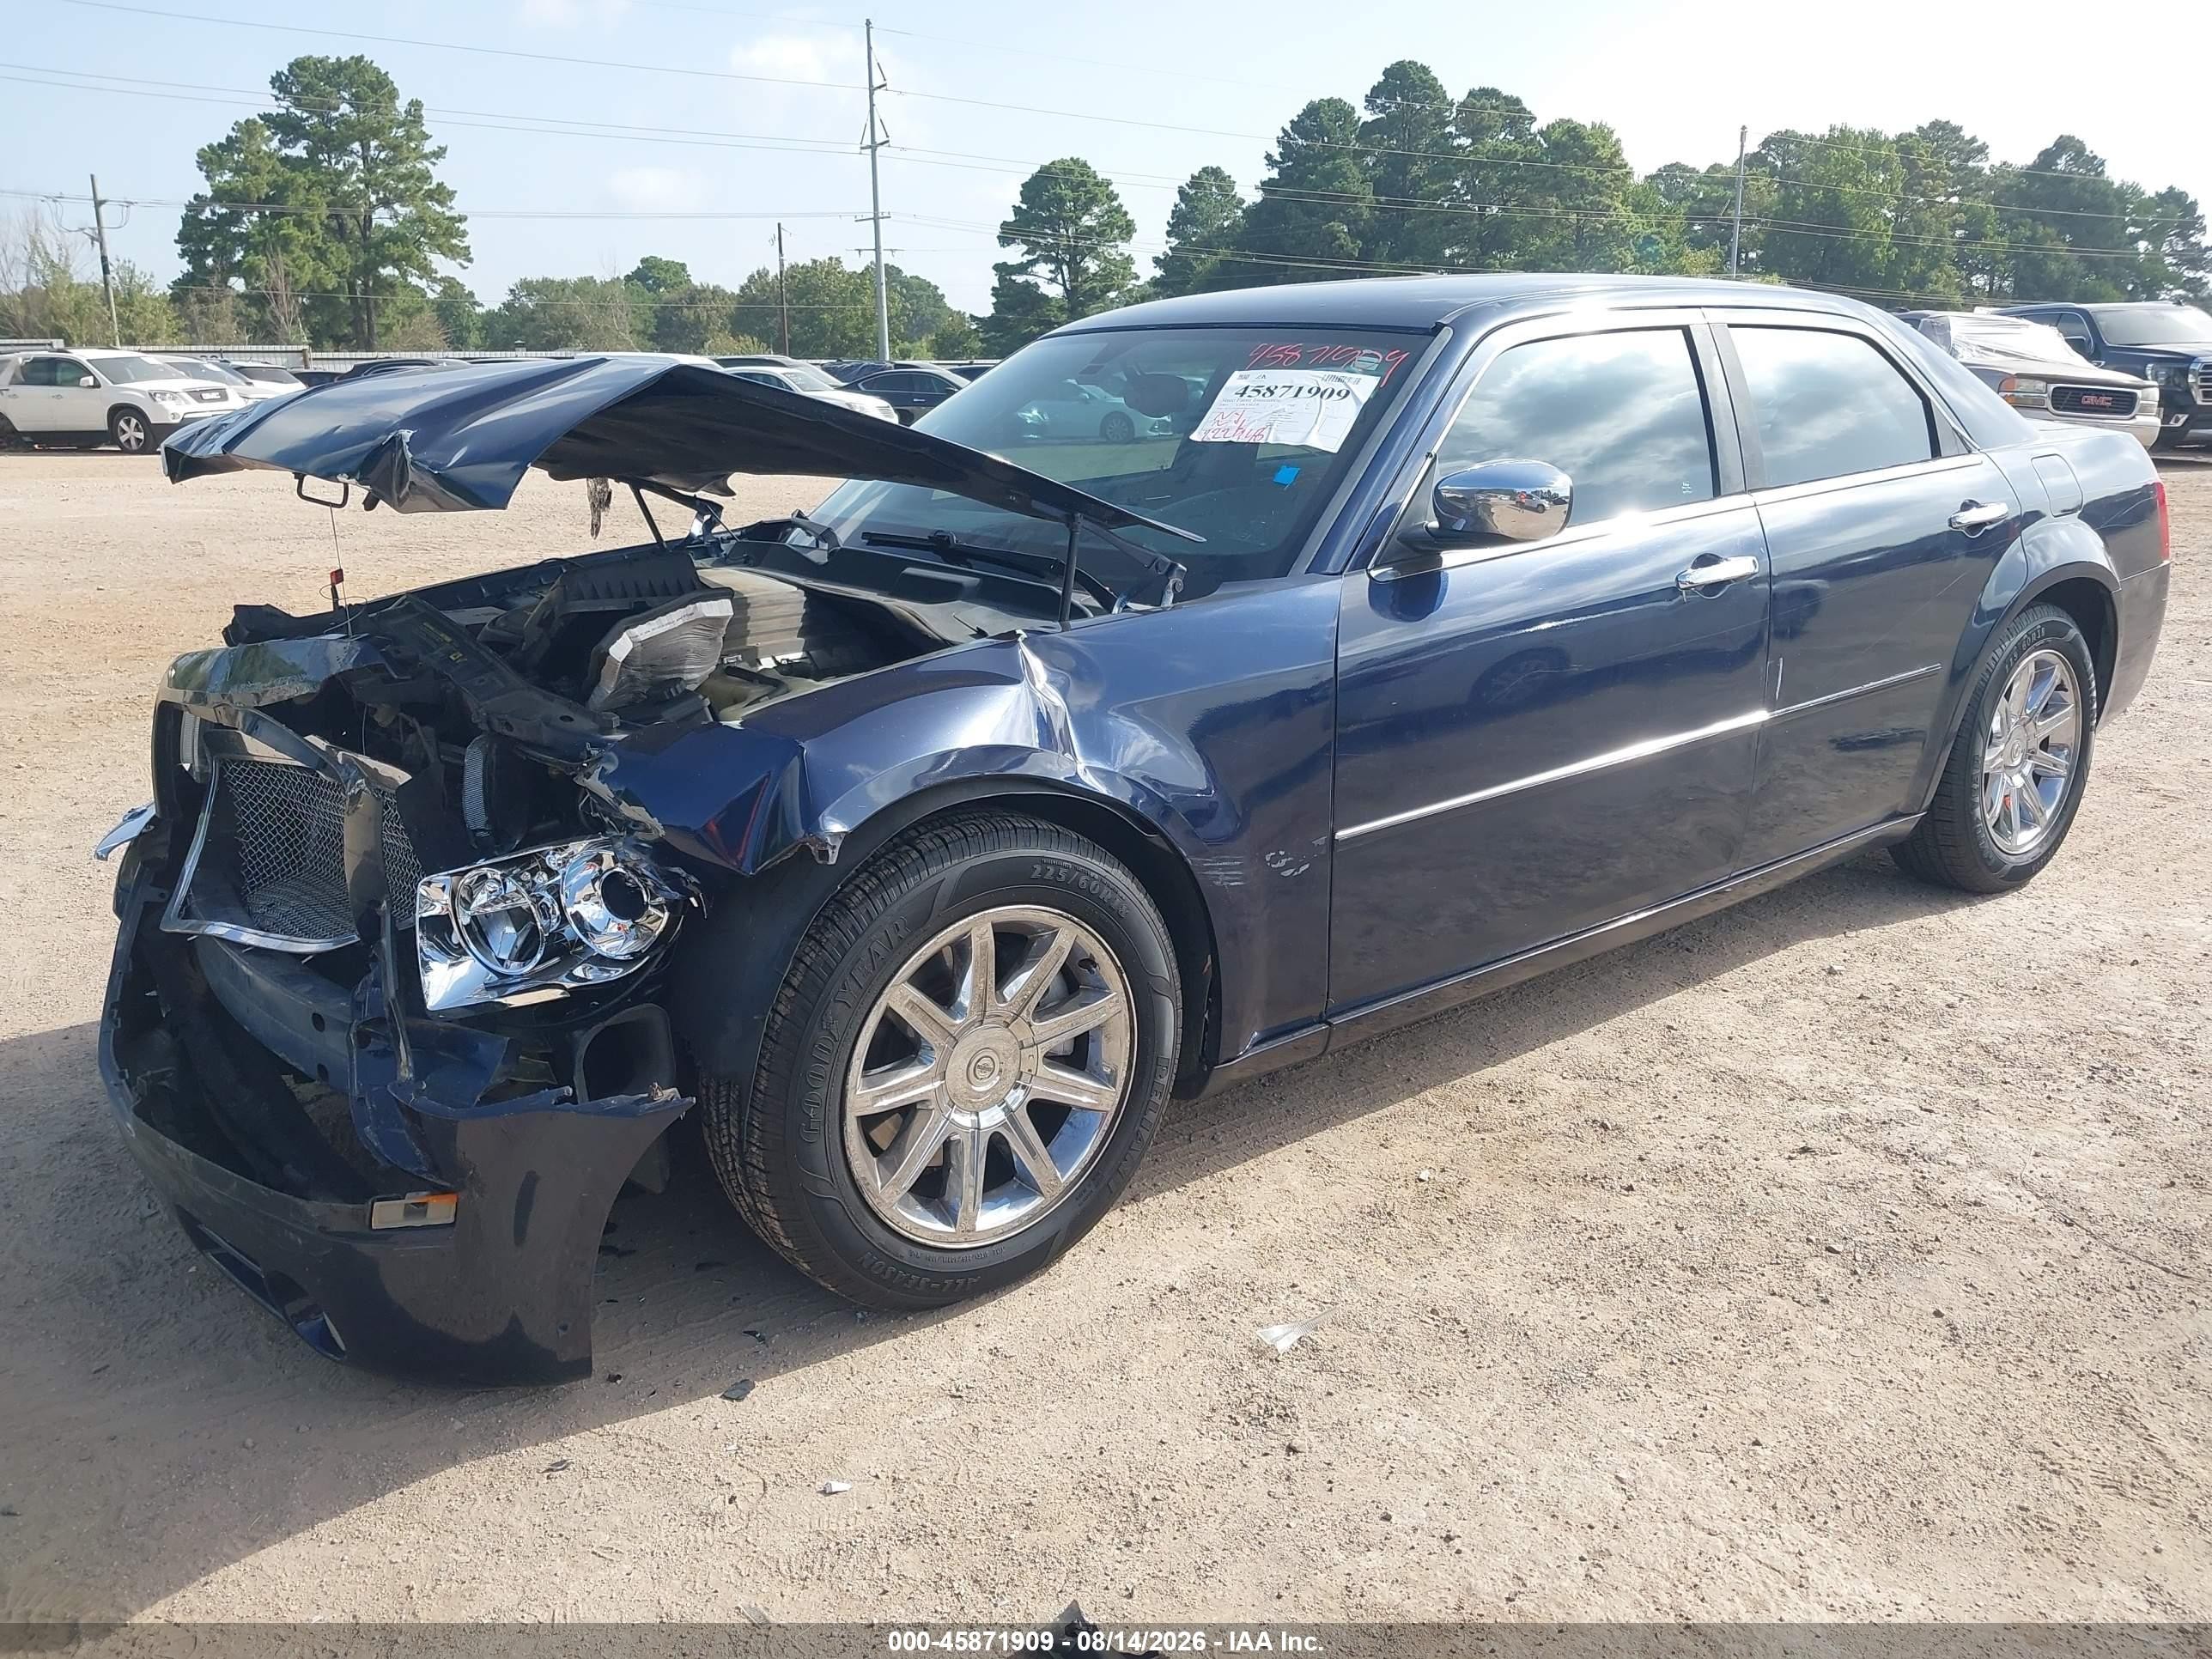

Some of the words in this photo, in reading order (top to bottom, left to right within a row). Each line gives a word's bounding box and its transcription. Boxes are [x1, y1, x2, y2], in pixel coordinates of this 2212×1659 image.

[1235, 384, 1351, 401] 45871909
[2081, 396, 2113, 405] GMC
[1030, 863, 1129, 919] 225/60R18
[857, 1251, 981, 1293] ALL-SEASON
